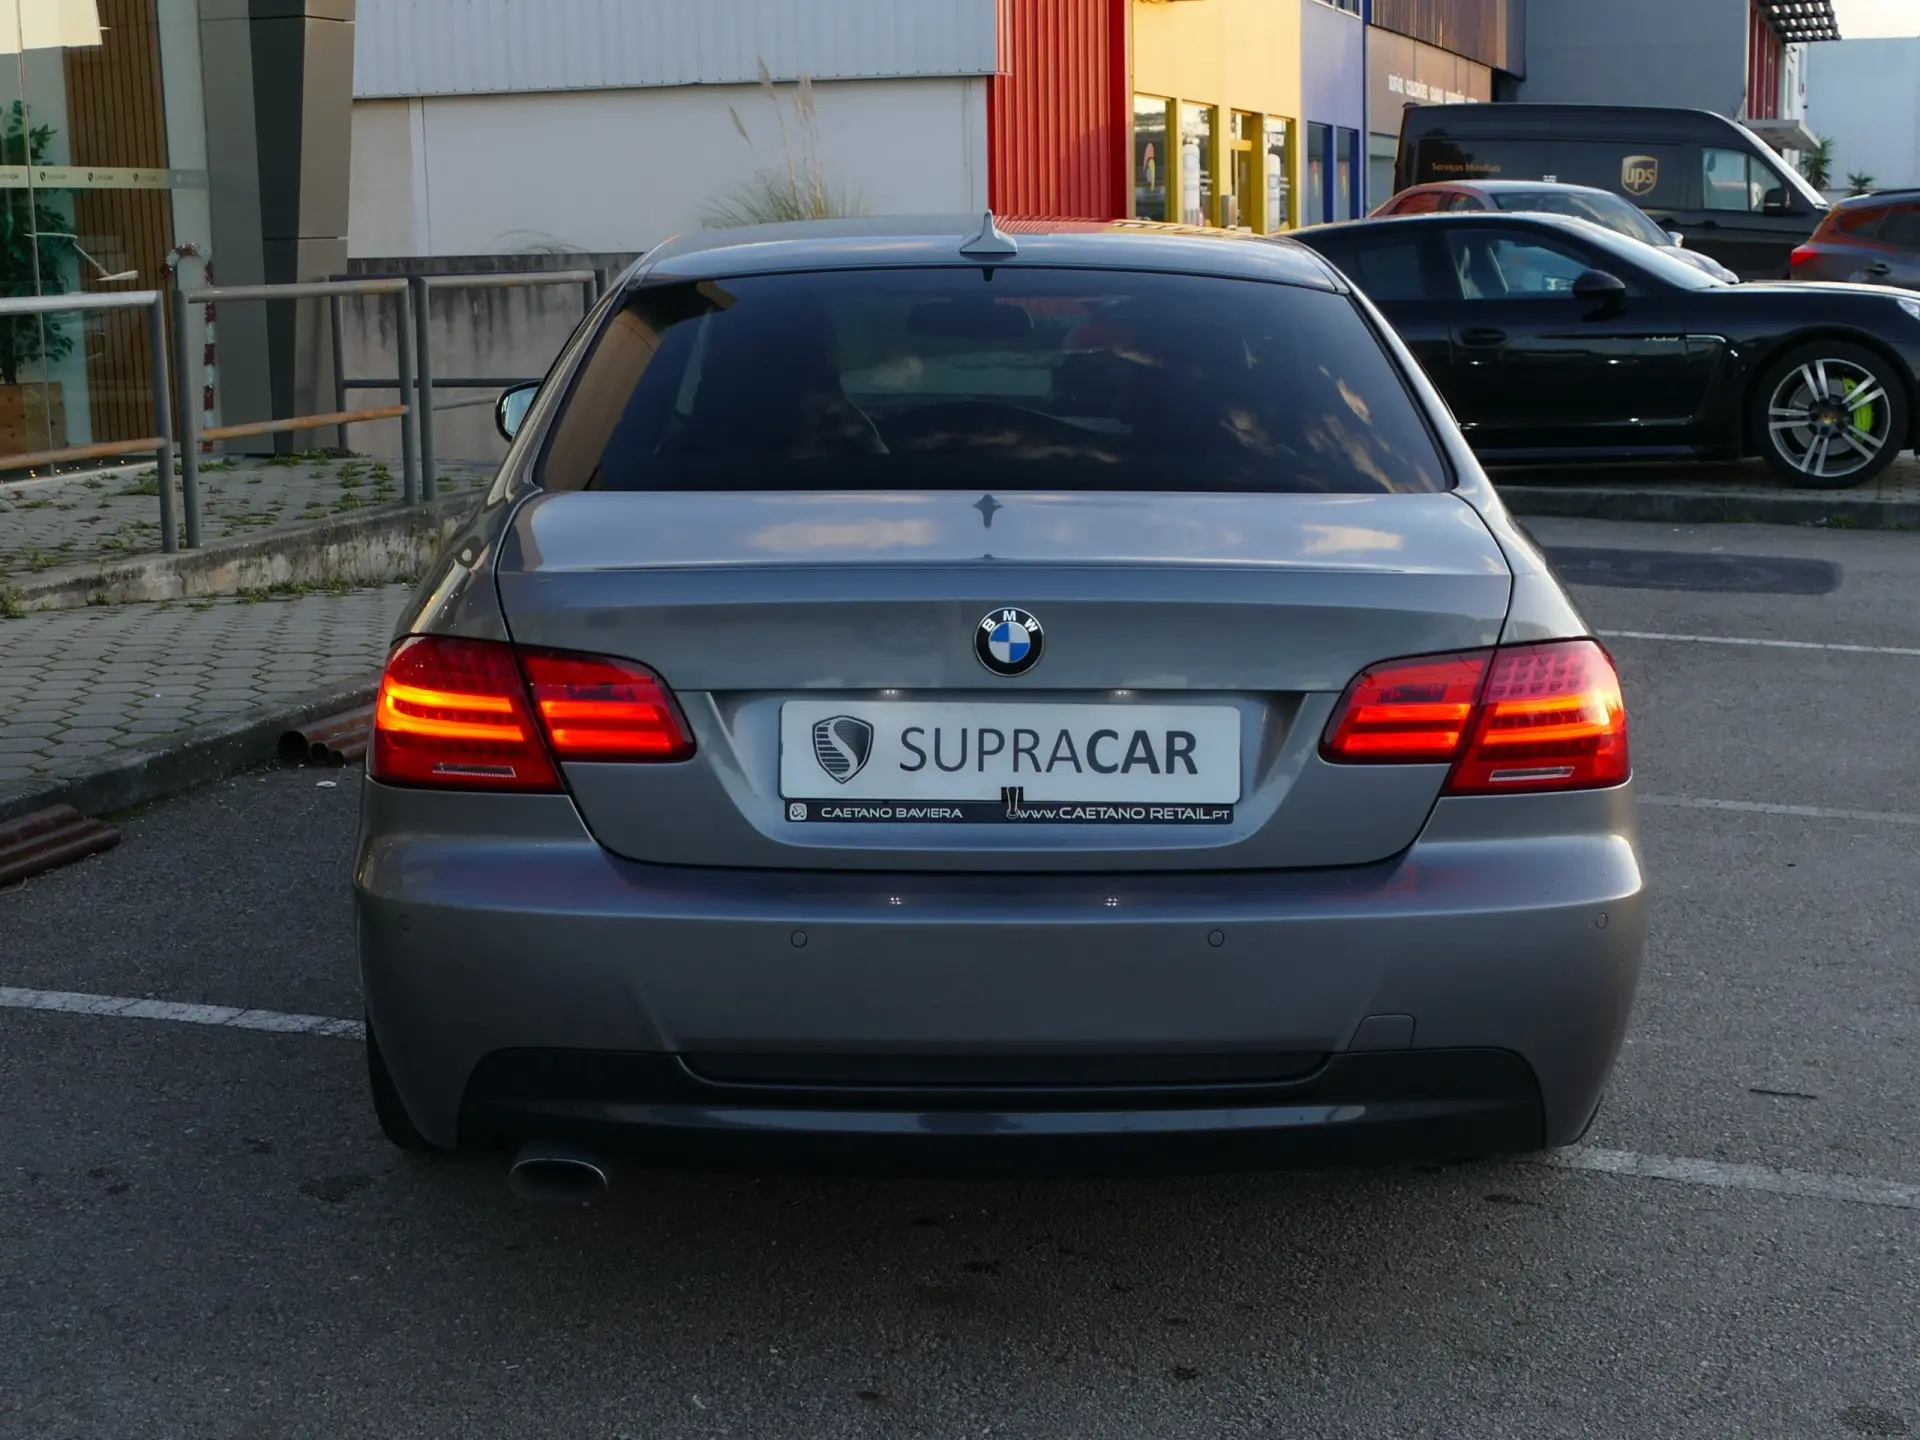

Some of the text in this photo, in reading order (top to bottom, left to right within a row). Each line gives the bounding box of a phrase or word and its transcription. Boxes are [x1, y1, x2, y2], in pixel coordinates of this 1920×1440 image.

[1625, 168, 1656, 189] ups
[981, 610, 1039, 633] BMW
[899, 727, 1199, 775] SUPRACAR
[821, 807, 963, 819] CAETANO BAVIERA
